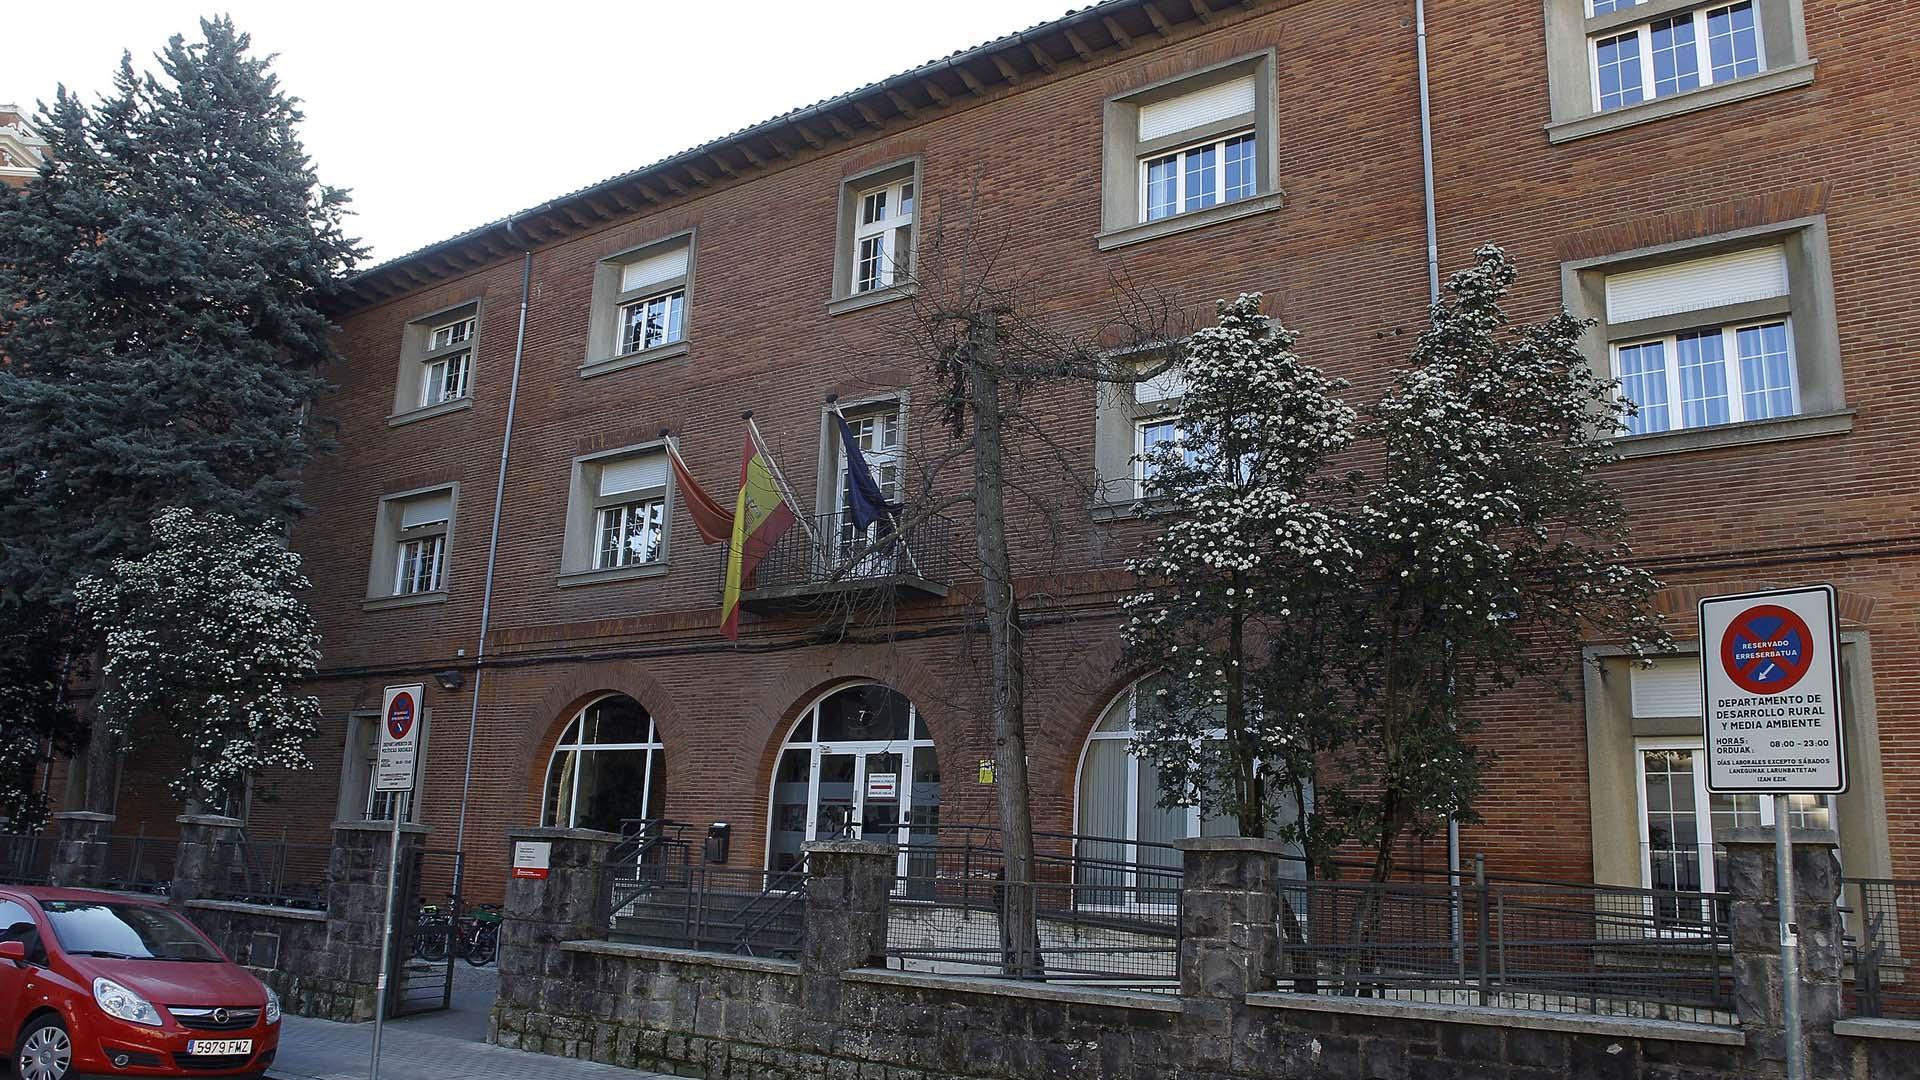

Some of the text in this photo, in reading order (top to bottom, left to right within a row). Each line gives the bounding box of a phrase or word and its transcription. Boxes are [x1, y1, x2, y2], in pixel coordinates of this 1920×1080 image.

[1743, 640, 1789, 650] RESERVADO
[1735, 649, 1798, 660] ERRESERBATUA
[1718, 694, 1822, 707] DEPARTAMENTO DE
[1716, 706, 1825, 719] DESARROLLO RURAL
[1721, 718, 1821, 730] Y MEDIA AMBIENTE
[1716, 737, 1748, 745] HORAS:
[1769, 740, 1795, 748] 08:00
[1803, 739, 1829, 747] 23:00
[1716, 746, 1754, 754] ORDUAK:
[197, 1041, 249, 1054] 5979 FMZ
